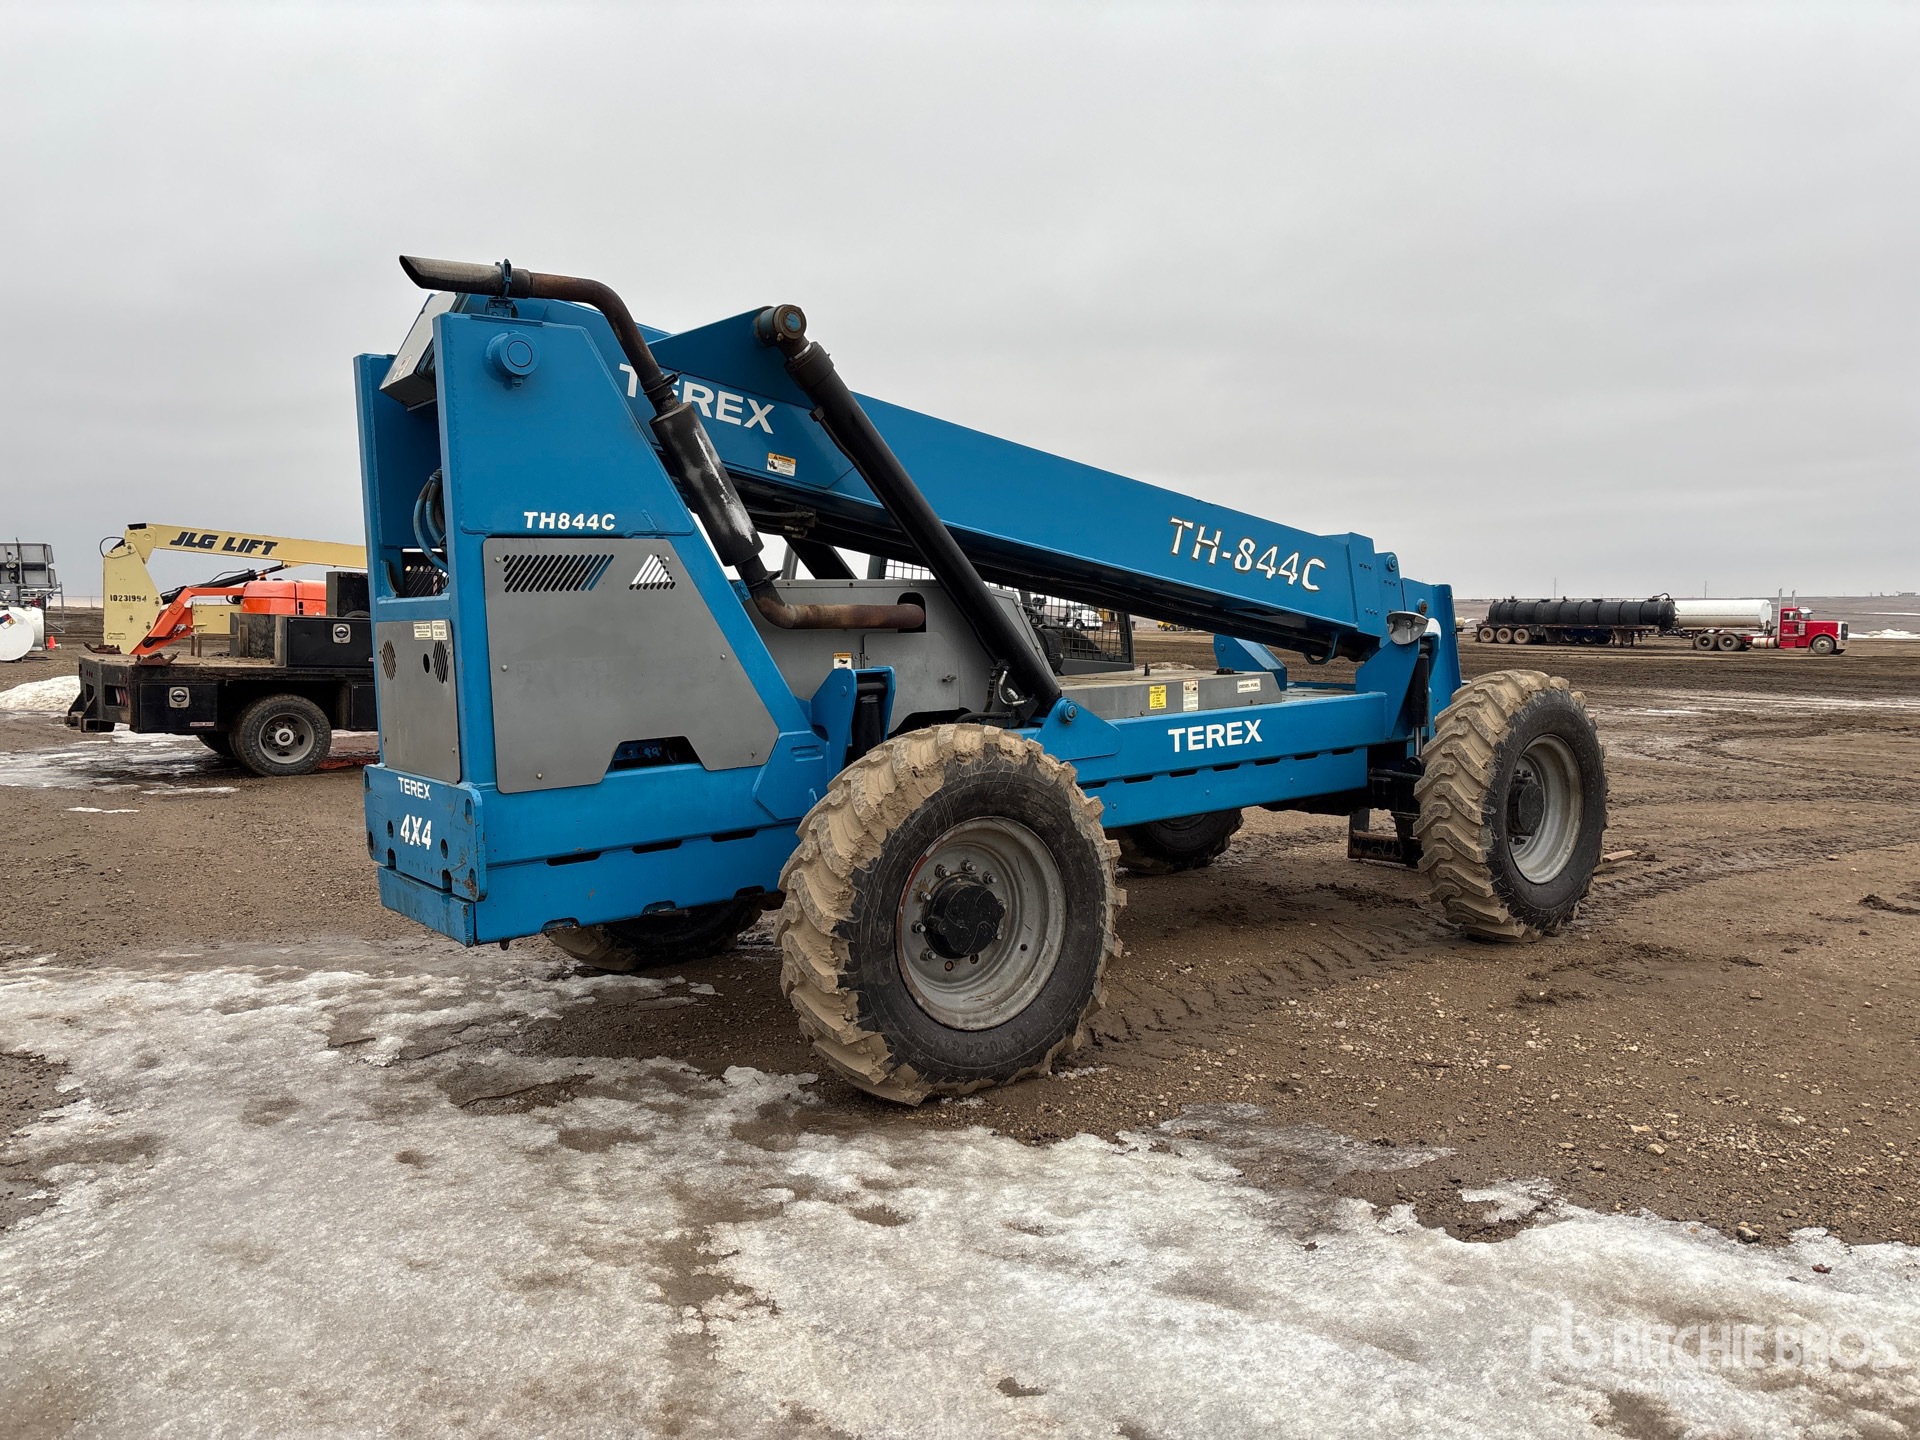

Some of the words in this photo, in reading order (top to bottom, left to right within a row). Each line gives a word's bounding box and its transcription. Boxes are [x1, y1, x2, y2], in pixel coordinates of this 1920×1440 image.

[618, 362, 775, 435] TREX
[523, 511, 616, 531] TH844C
[169, 531, 219, 549] JLG
[222, 537, 278, 555] LIFT
[1170, 517, 1327, 591] TH-844C
[1167, 718, 1263, 753] TEREX
[398, 778, 431, 801] TEREX
[400, 813, 432, 850] 4X4
